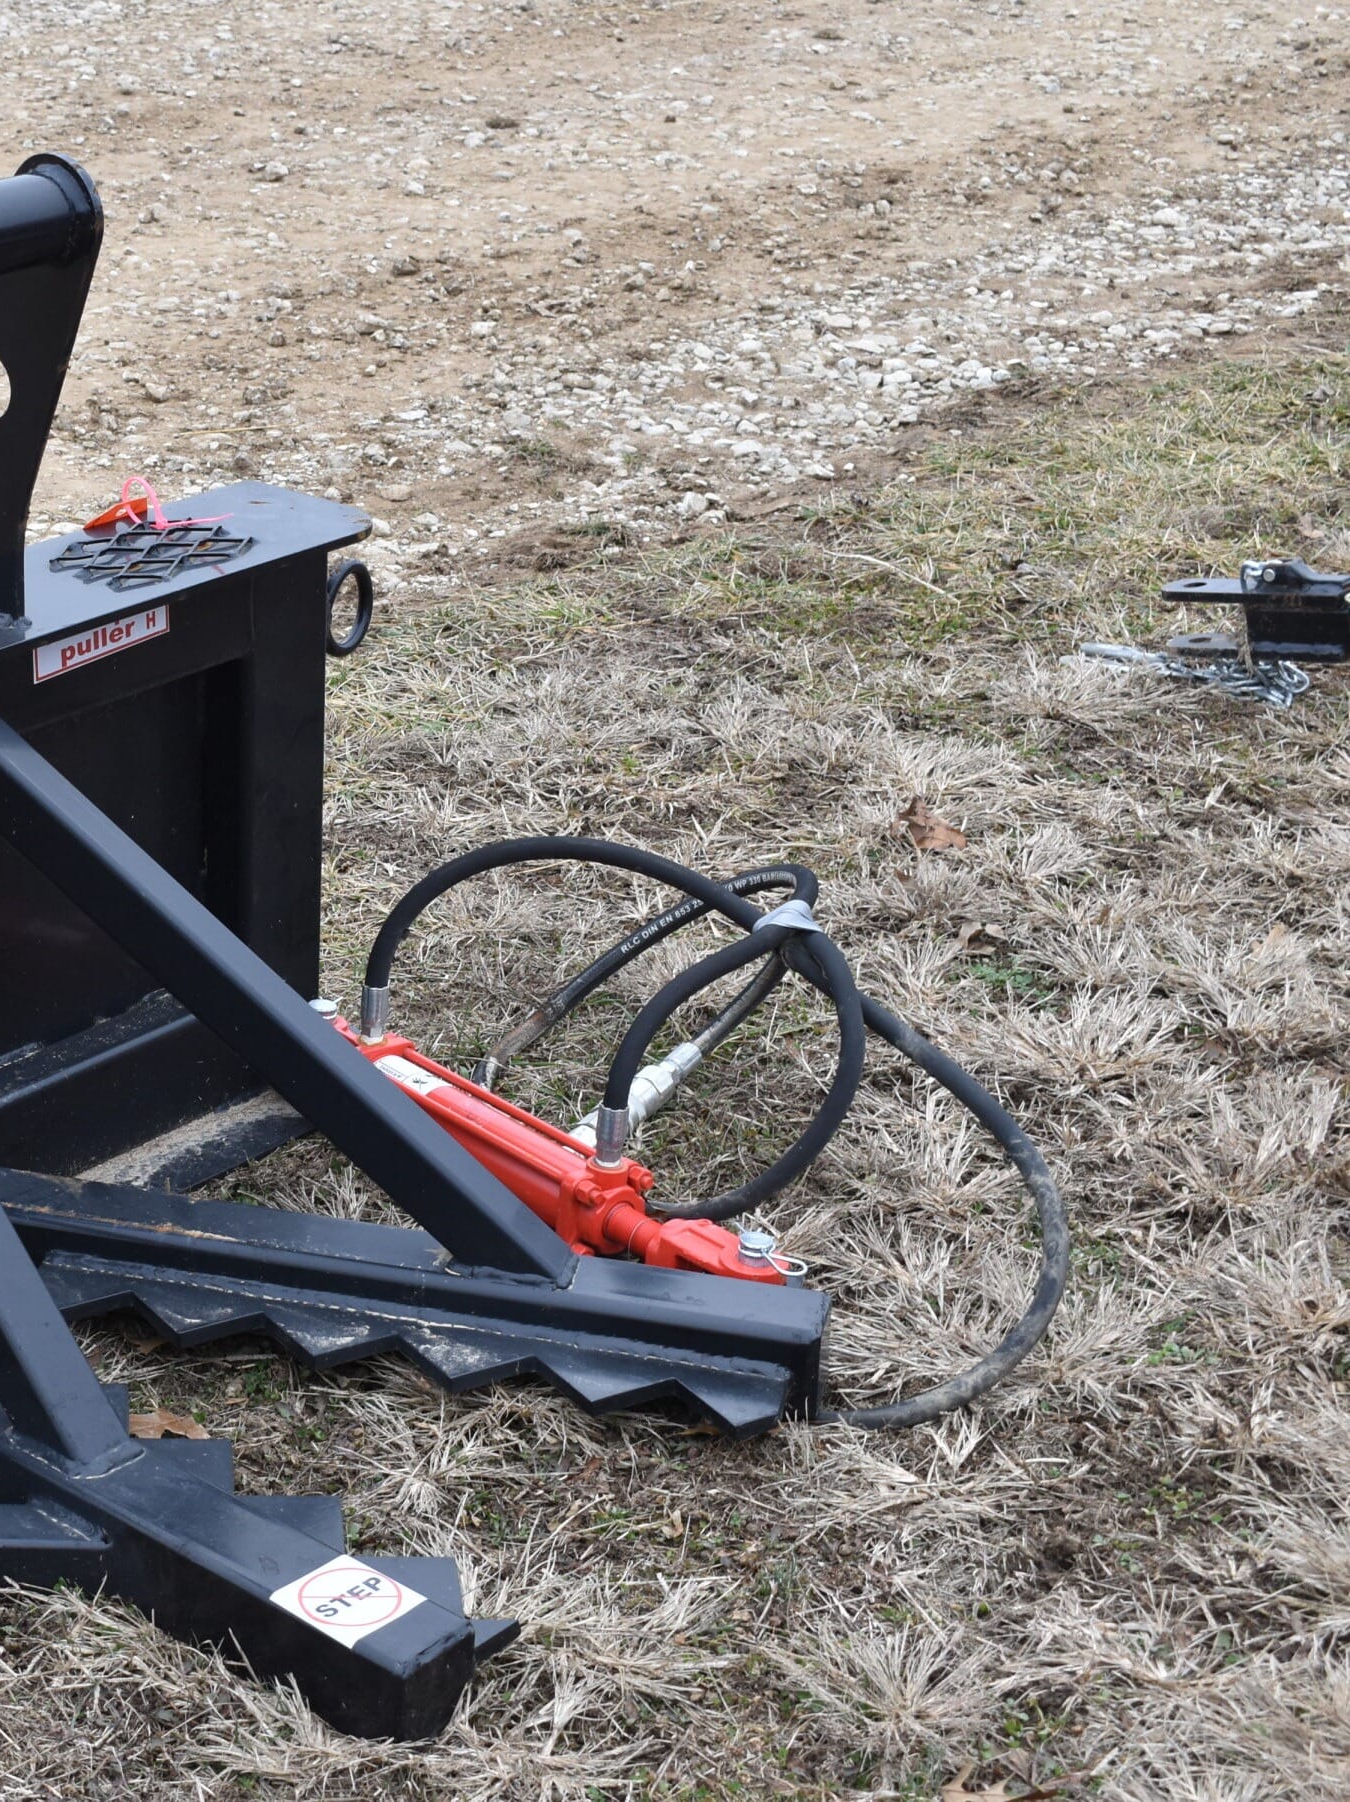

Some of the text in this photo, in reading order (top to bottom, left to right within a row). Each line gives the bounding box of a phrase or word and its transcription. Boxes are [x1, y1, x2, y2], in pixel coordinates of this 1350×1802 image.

[61, 611, 156, 668] puller H
[620, 937, 641, 953] RLC
[641, 925, 659, 939] DIN
[659, 915, 673, 927] EN
[315, 1577, 382, 1618] STEP
